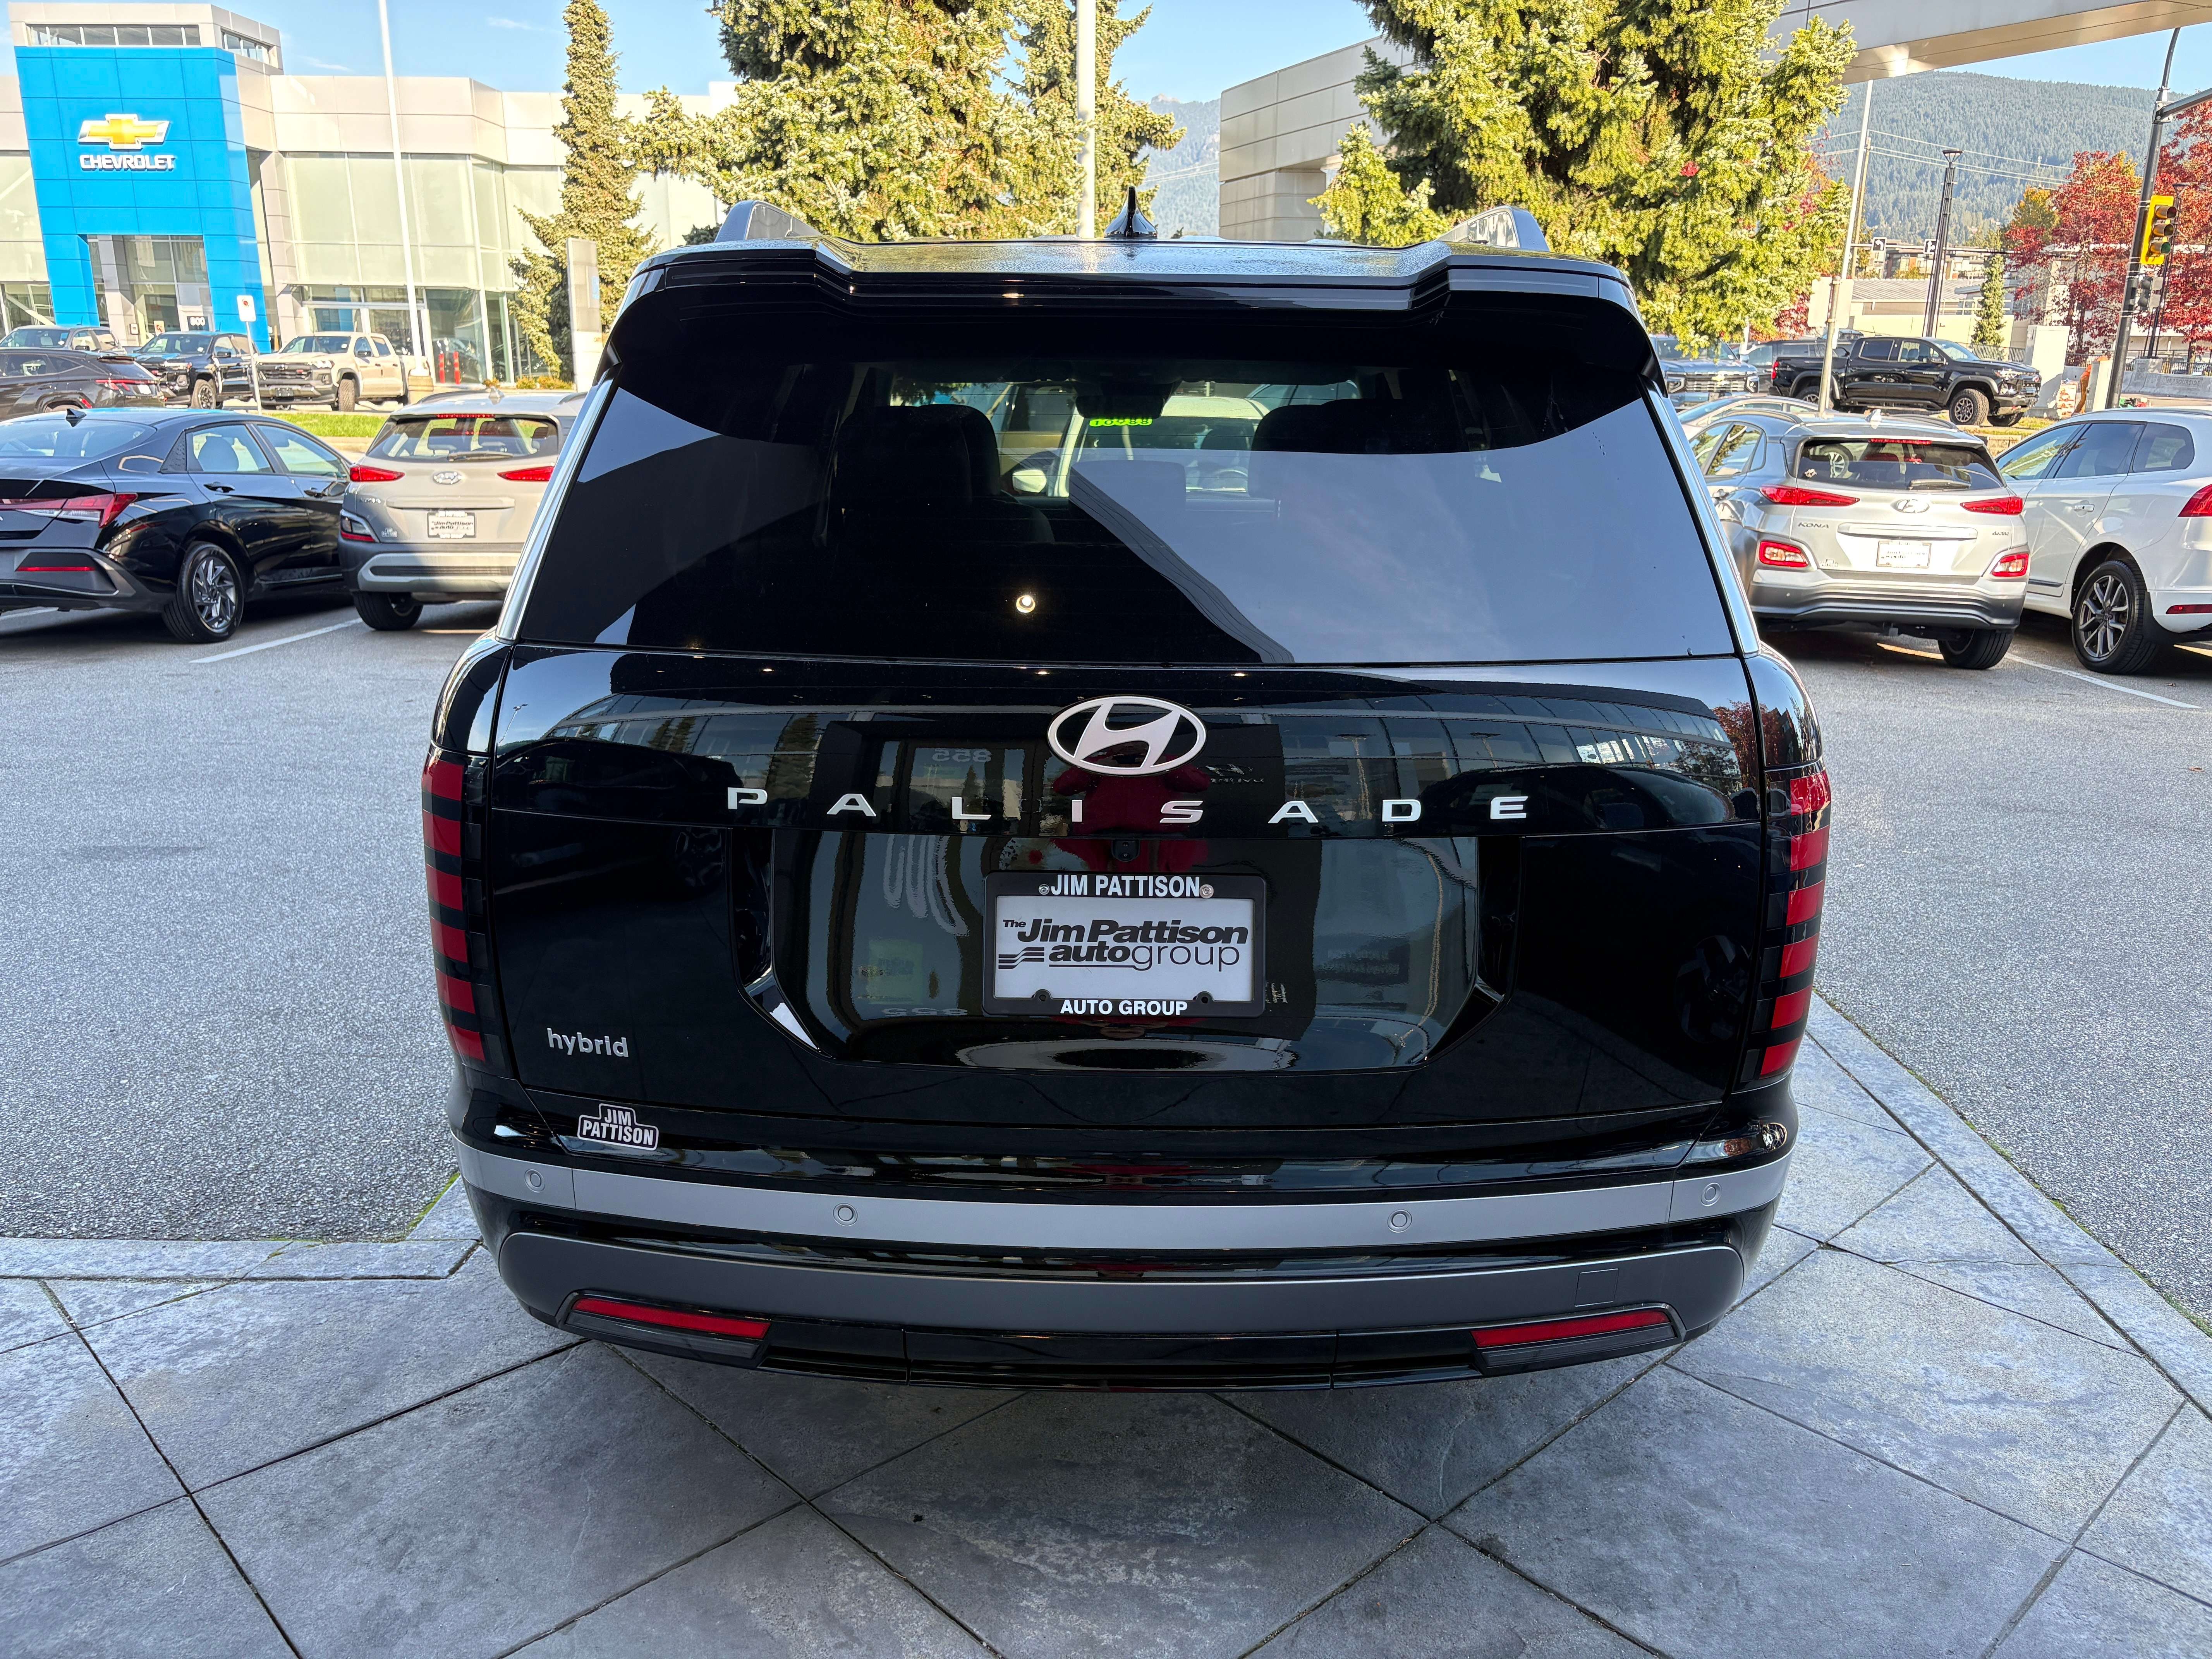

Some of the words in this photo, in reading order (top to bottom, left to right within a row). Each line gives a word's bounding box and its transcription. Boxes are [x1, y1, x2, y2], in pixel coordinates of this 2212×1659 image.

[80, 155, 175, 170] CHEVROLET
[727, 787, 1528, 824] PALISADE
[1051, 874, 1088, 896] JIM
[1095, 875, 1200, 898] PATTISON
[1003, 919, 1027, 928] The
[1018, 918, 1085, 943] Jim
[1087, 919, 1249, 944] Pattison
[1060, 999, 1113, 1015] AUTO
[1118, 1000, 1188, 1015] GROUP
[547, 1027, 629, 1058] hybrid
[604, 1108, 632, 1126] JIM
[582, 1120, 654, 1146] PATTISON
